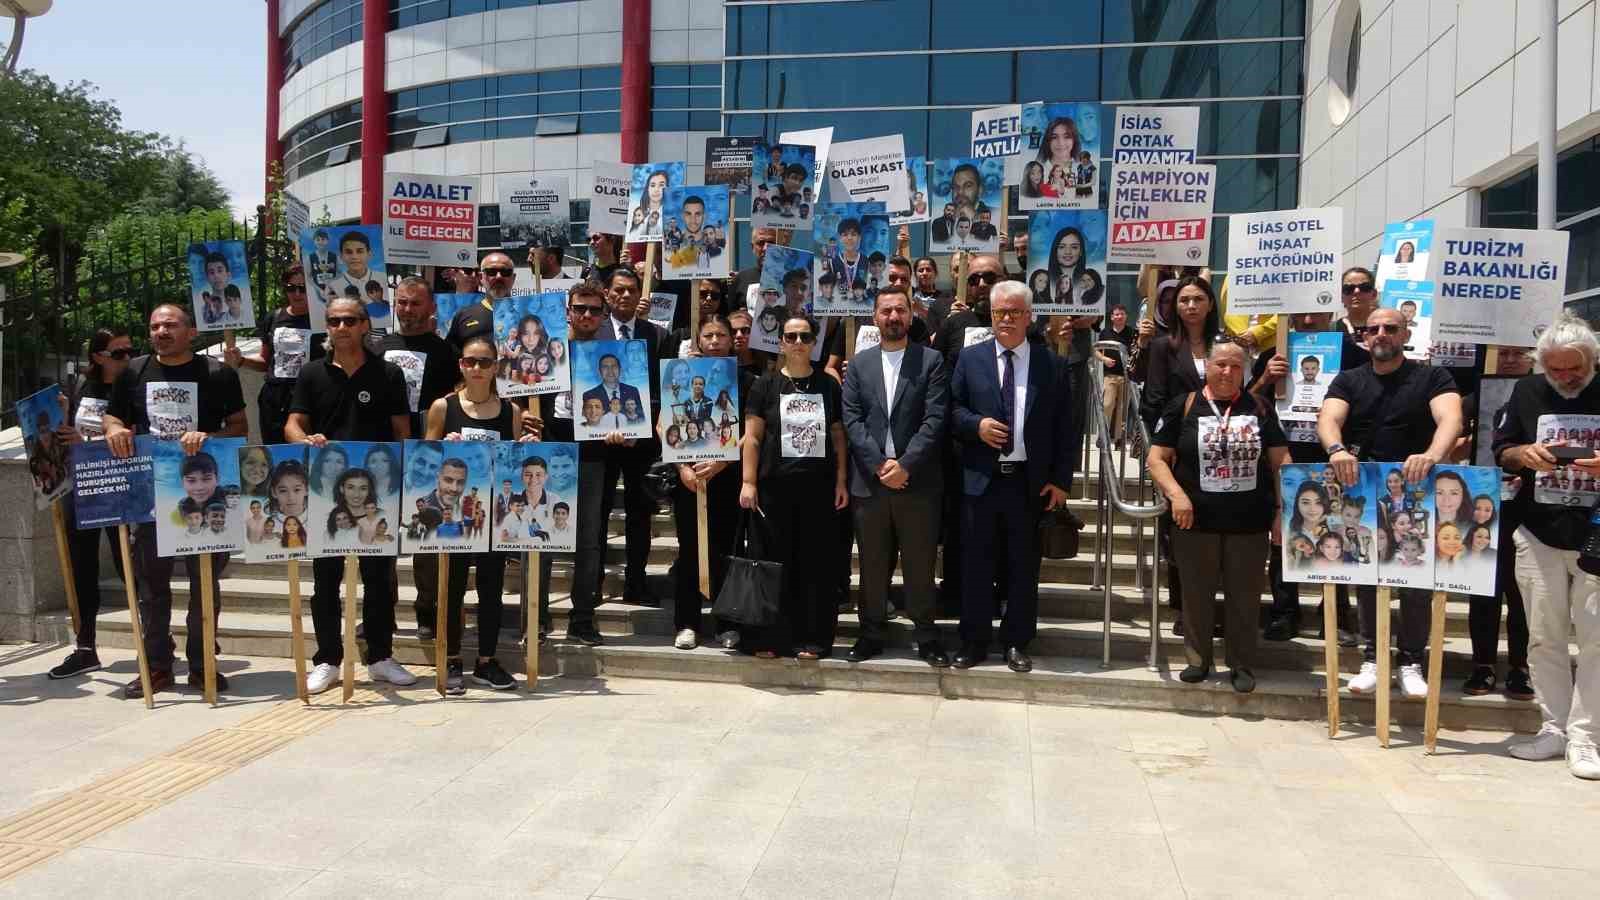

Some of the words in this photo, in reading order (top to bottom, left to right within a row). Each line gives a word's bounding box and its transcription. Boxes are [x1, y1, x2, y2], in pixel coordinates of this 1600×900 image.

[976, 116, 1019, 137] AFET
[1121, 114, 1162, 129] İSİAS
[1120, 134, 1174, 147] ORTAK
[1118, 151, 1190, 164] DAVAMIZ
[831, 168, 867, 178] OLASI
[871, 161, 904, 174] KAST
[1117, 168, 1209, 186] ŞAMPİYON
[393, 182, 473, 200] ADALET
[595, 185, 630, 197] OLASI
[1116, 188, 1206, 203] MELEKLER
[390, 203, 432, 217] OLASI
[436, 206, 472, 219] KAST
[1115, 202, 1149, 220] İÇİN
[389, 223, 404, 236] İLE
[409, 225, 472, 239] GELECEK
[1115, 220, 1201, 242] ADALET
[1248, 221, 1283, 234] İSİAS
[1288, 220, 1324, 231] OTEL
[1259, 237, 1311, 251] İNŞAAT
[1446, 238, 1523, 257] TURİZM
[1235, 252, 1334, 269] SEKTÖRÜNÜN
[1235, 269, 1333, 285] FELAKETİDİR!
[1444, 261, 1557, 280] BAKANLIĞI
[1442, 283, 1522, 300] NEREDE
[76, 465, 139, 479] HAZIRLAYANLAR
[77, 477, 127, 487] DURUŞMAYA
[78, 486, 115, 496] GELECEK
